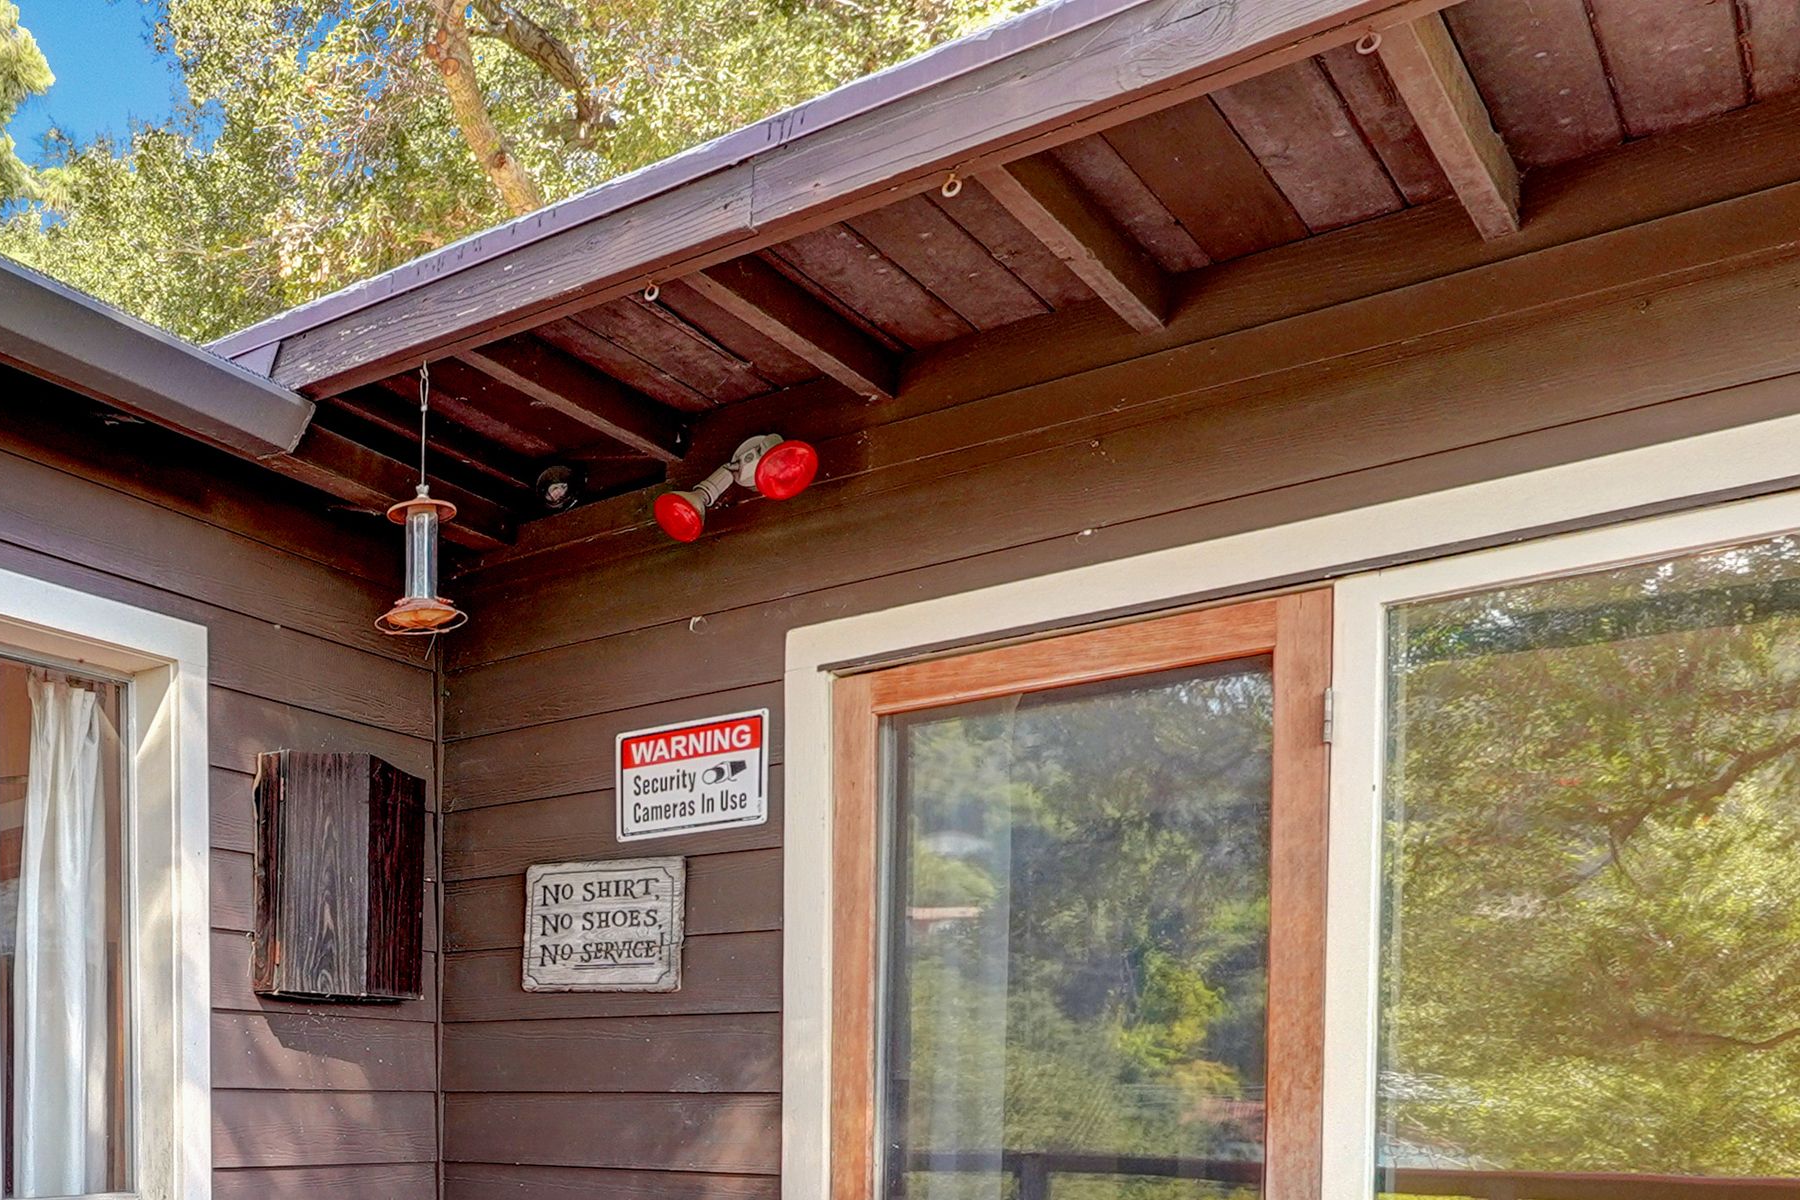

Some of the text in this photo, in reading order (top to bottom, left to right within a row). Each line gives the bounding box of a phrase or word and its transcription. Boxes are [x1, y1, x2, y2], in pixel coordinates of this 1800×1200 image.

[631, 724, 751, 765] WARNING
[633, 769, 696, 796] Security
[634, 800, 695, 823] Cameras
[702, 793, 714, 814] In
[721, 790, 747, 811] Use
[541, 879, 660, 906] NO SHIRT,
[540, 909, 662, 936] NO SHOES,
[539, 932, 665, 967] NO SERVICE!
